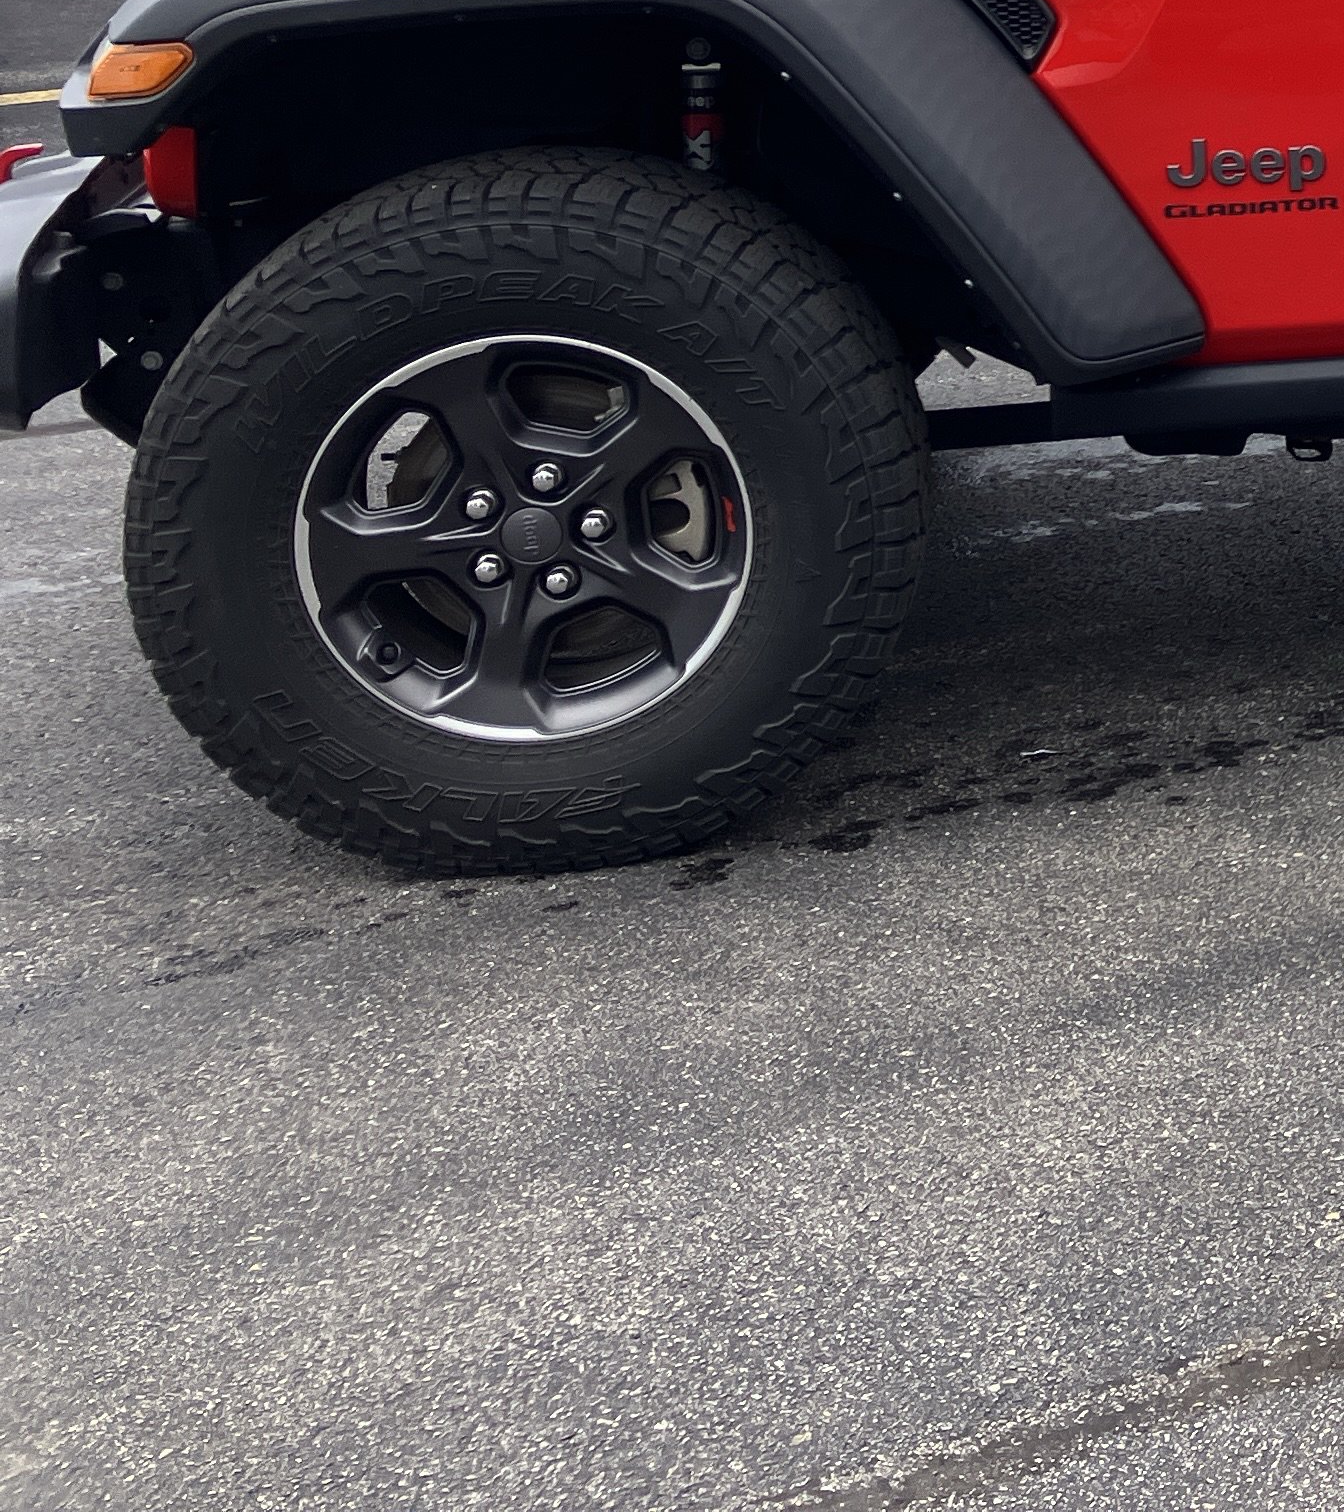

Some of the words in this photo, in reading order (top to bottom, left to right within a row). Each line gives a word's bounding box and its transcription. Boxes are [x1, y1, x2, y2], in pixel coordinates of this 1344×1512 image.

[1164, 196, 1340, 220] GLADIATOR
[1166, 138, 1327, 192] Jeep
[233, 266, 666, 456] WILDPEAK
[252, 688, 642, 824] FALKEN
